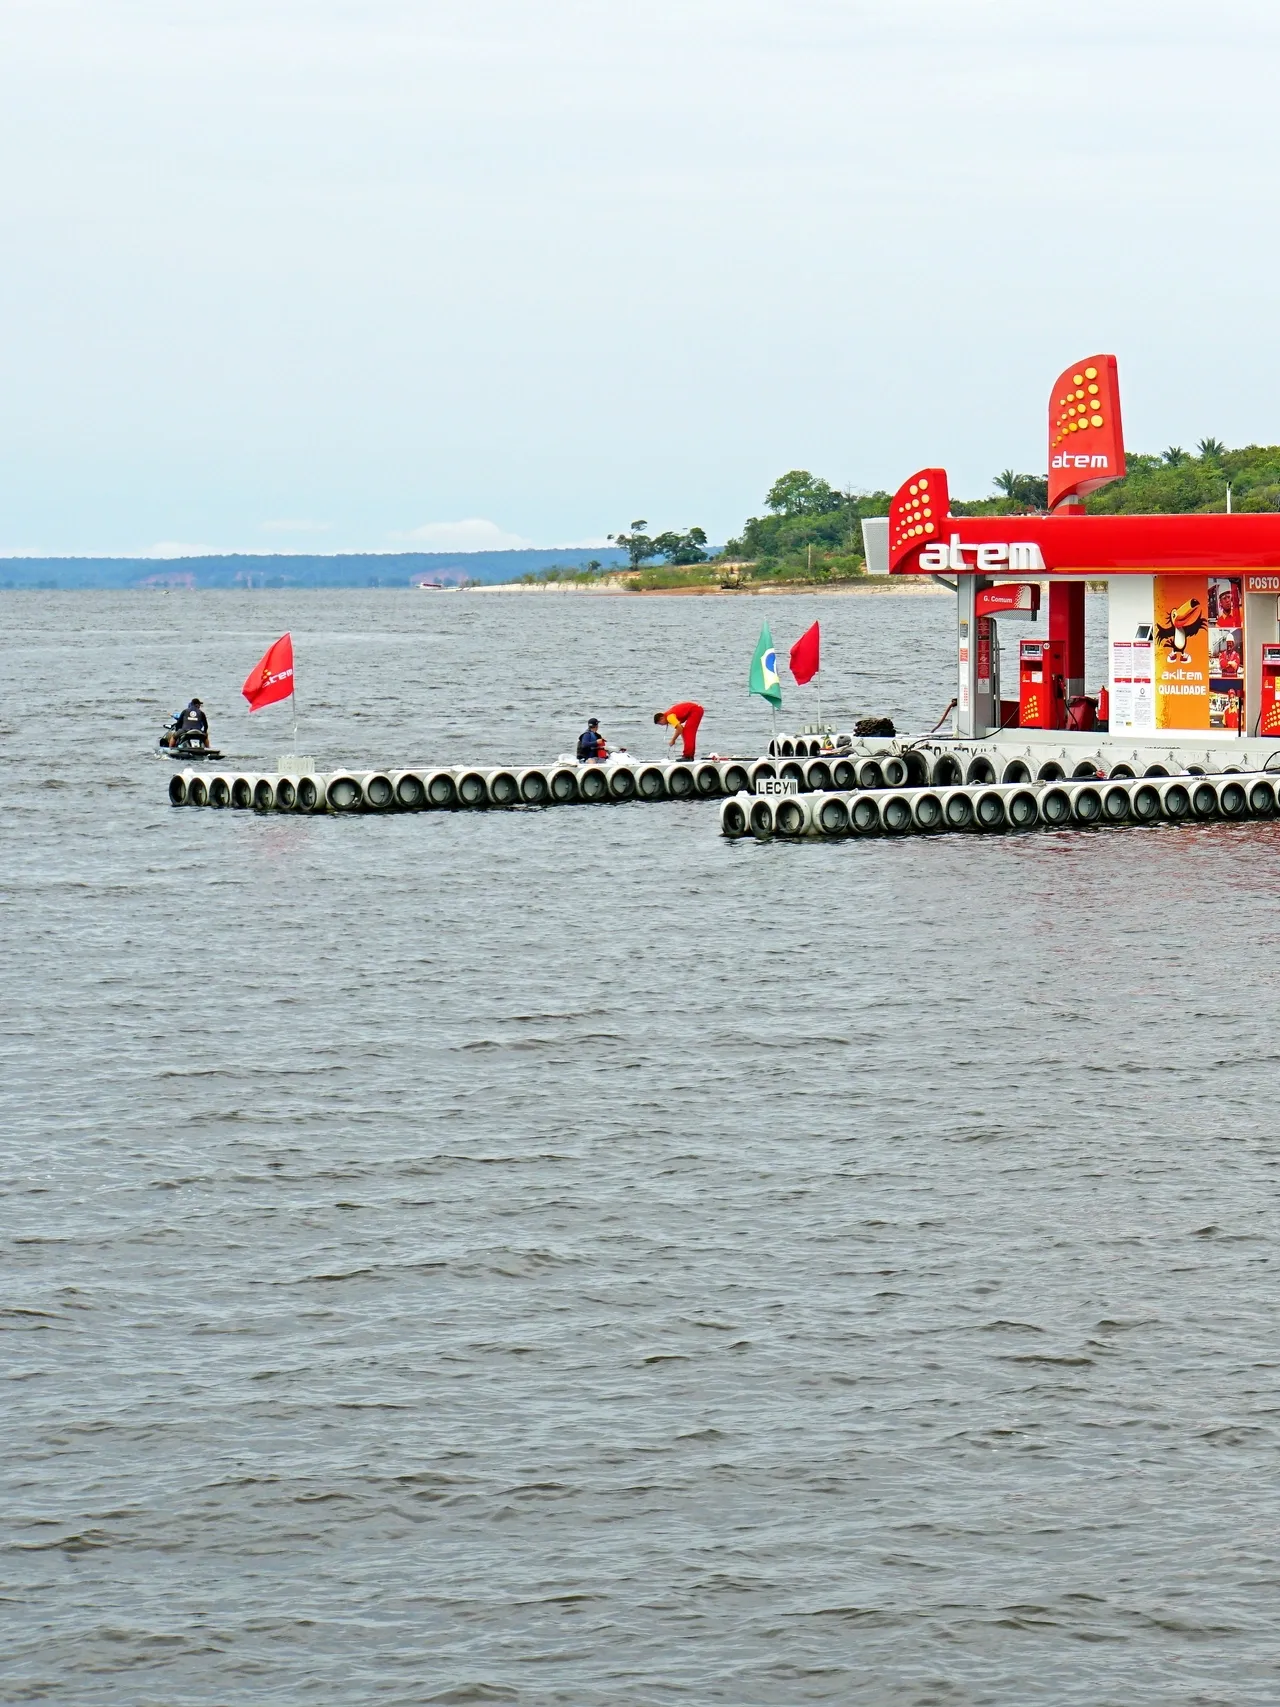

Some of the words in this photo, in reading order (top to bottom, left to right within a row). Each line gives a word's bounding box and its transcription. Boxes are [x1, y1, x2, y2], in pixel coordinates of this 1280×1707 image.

[1051, 451, 1108, 468] atem
[919, 533, 1046, 571] atem
[1250, 577, 1279, 588] POSTO
[991, 595, 1012, 603] Comum
[1162, 670, 1203, 680] akitem
[1159, 685, 1206, 695] QUALIDADE
[758, 782, 789, 795] LECY
